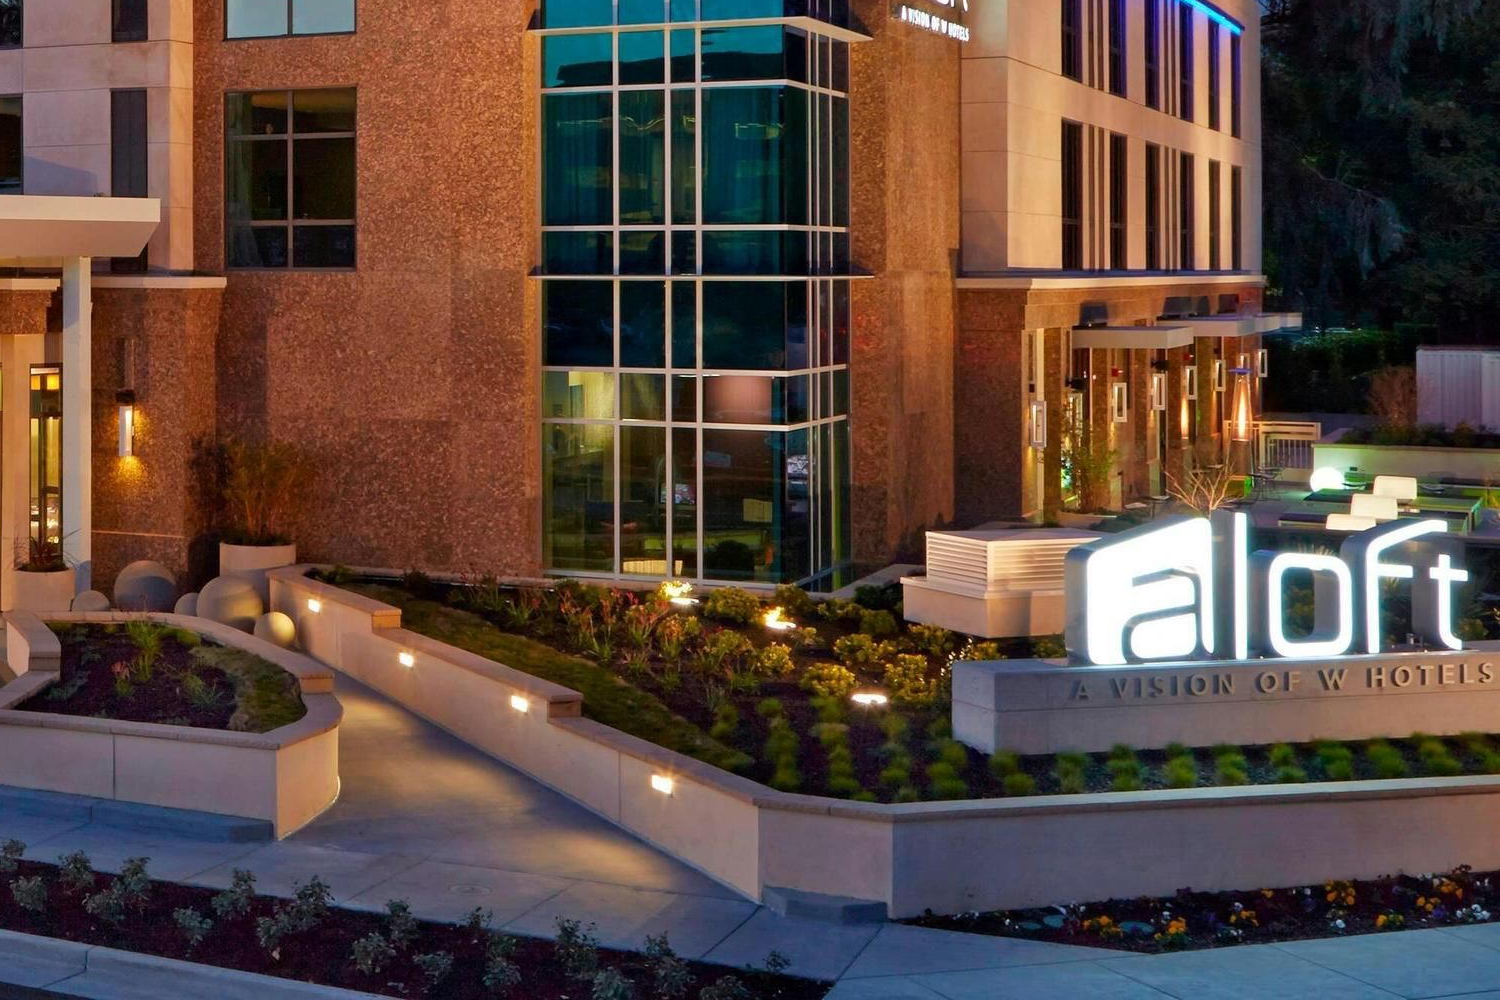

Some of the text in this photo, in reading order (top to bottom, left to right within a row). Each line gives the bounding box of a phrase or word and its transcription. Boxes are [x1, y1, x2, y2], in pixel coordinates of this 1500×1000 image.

[901, 5, 907, 20] A
[1086, 511, 1469, 664] aloft
[1072, 662, 1494, 700] A VISION OF W HOTELS
